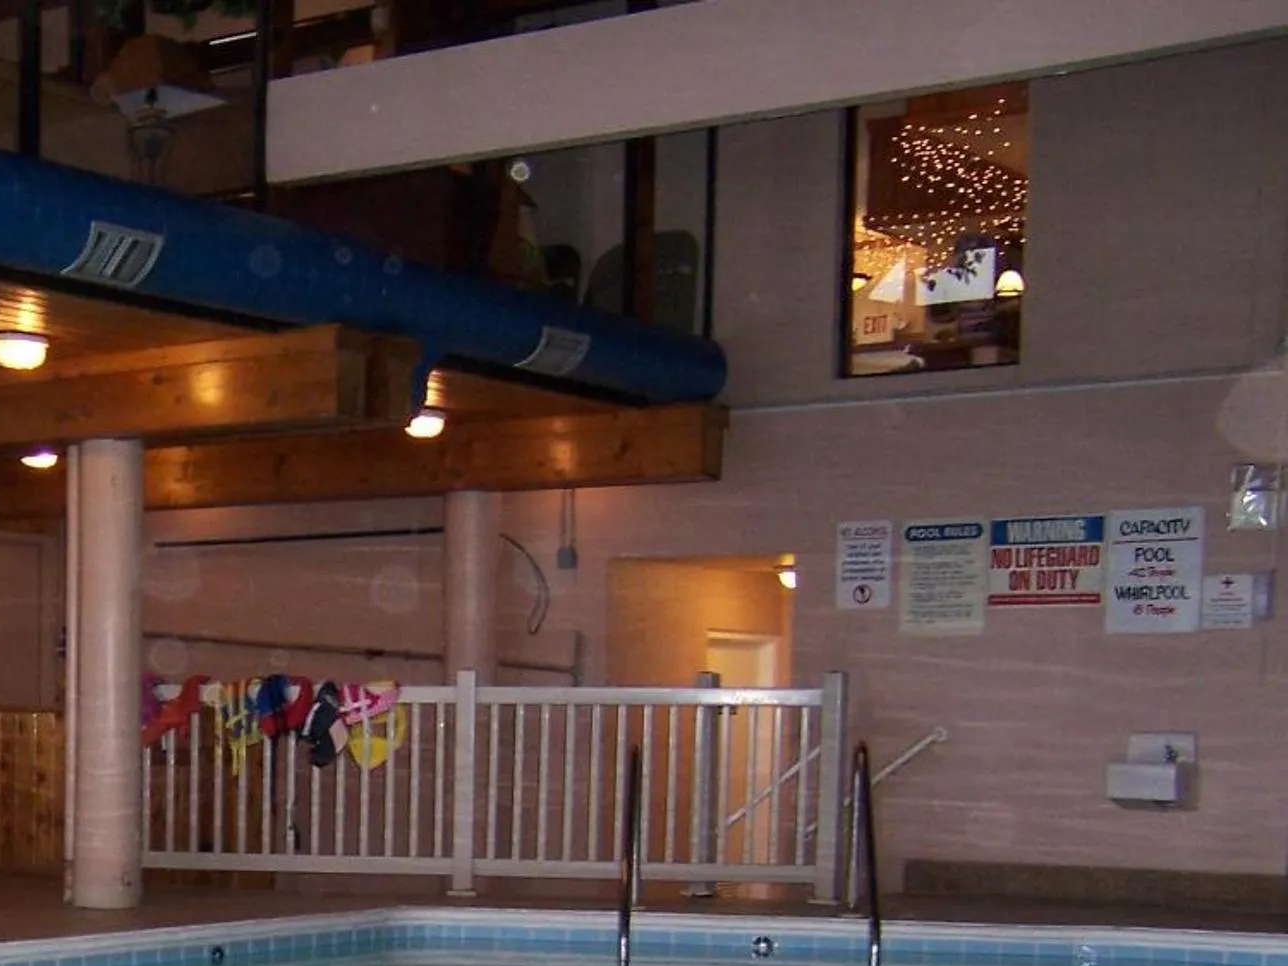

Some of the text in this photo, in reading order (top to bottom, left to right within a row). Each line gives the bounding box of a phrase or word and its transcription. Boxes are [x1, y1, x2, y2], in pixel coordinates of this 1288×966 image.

[863, 315, 888, 335] EXIT
[909, 528, 941, 539] POOL
[1006, 519, 1086, 543] WARNING
[1119, 518, 1191, 536] CAPACITY
[990, 546, 1100, 569] NO LIFEGUARD
[1134, 547, 1175, 563] POOL
[1009, 569, 1080, 591] ON DUTY
[1113, 585, 1191, 601] WHIRLPOOL
